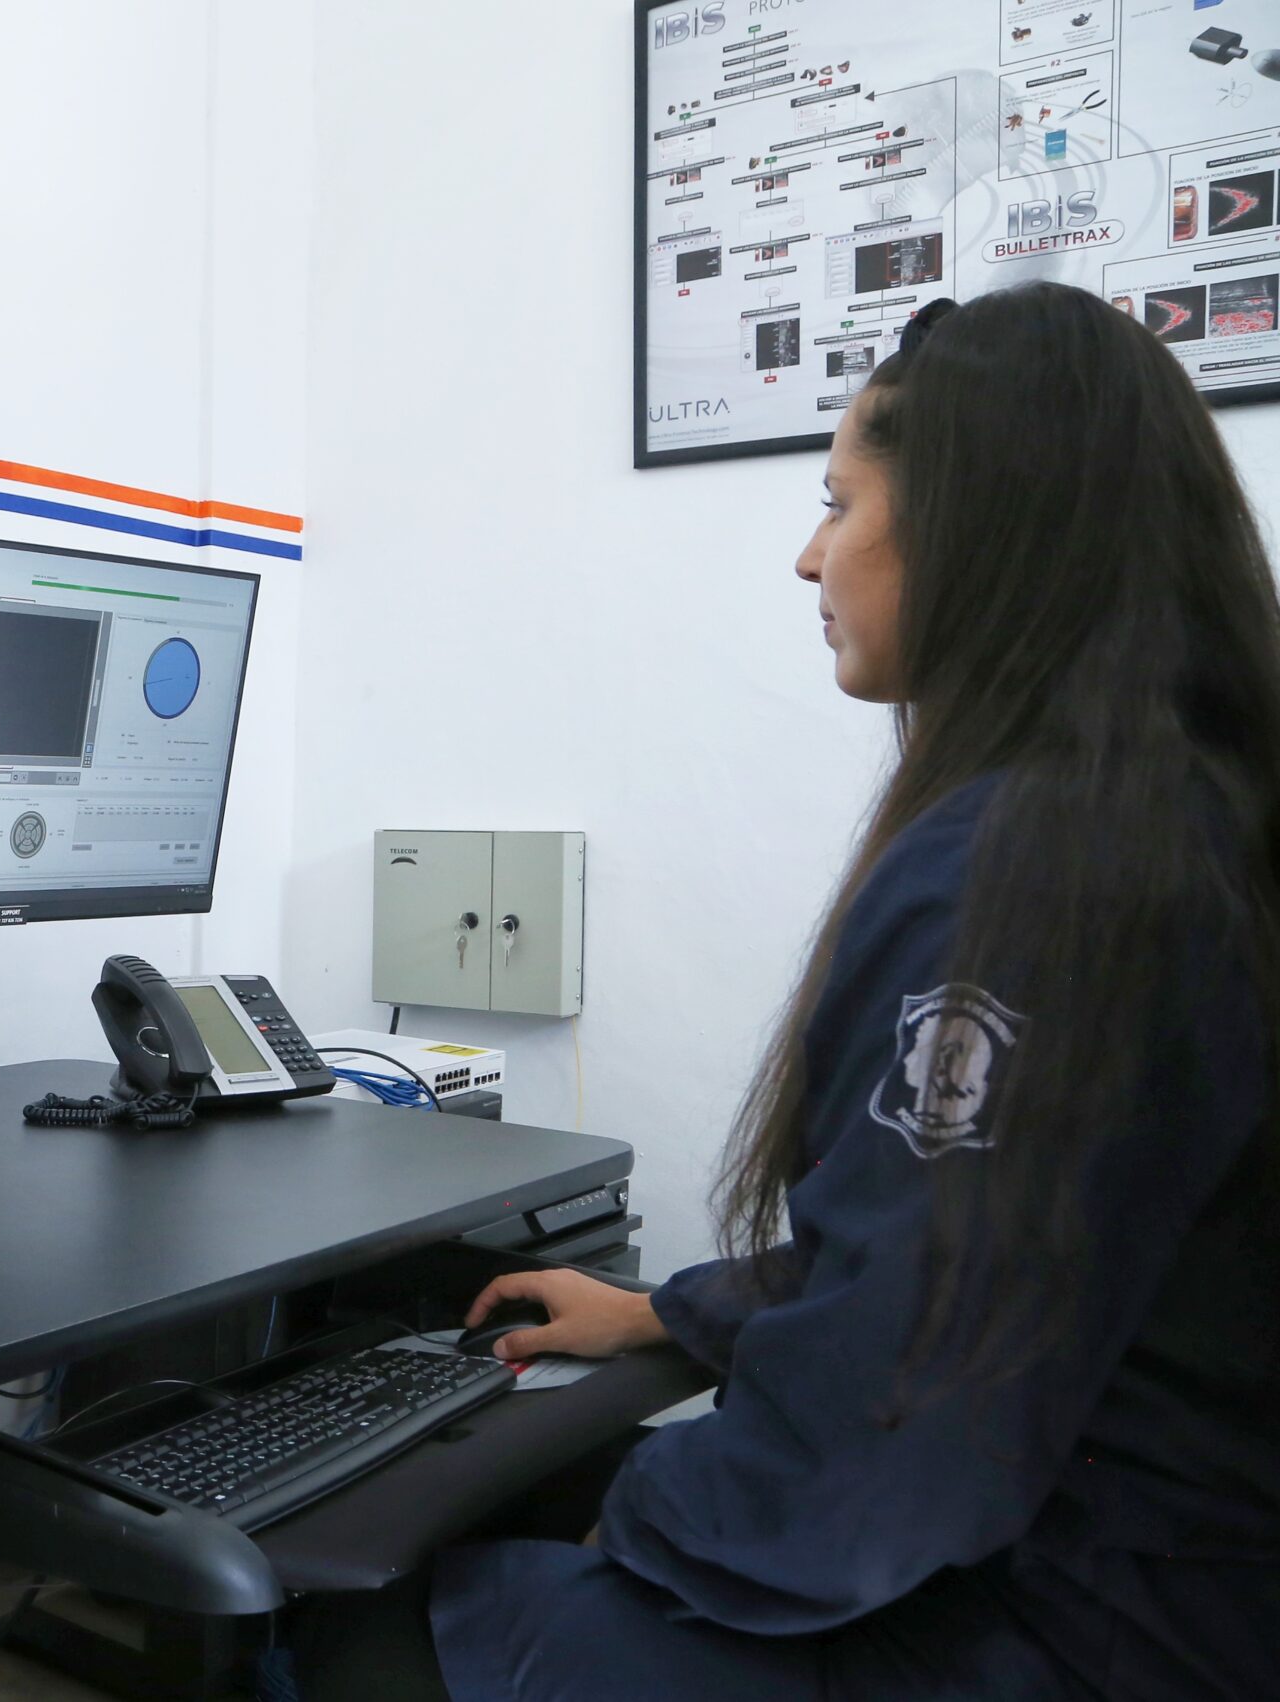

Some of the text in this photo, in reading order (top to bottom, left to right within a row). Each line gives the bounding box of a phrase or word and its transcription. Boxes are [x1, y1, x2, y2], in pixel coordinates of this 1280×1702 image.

[654, 2, 726, 49] IBIS
[1008, 190, 1097, 238] IBIS
[995, 226, 1110, 256] BULLETTRAX
[648, 397, 730, 423] ULTRA
